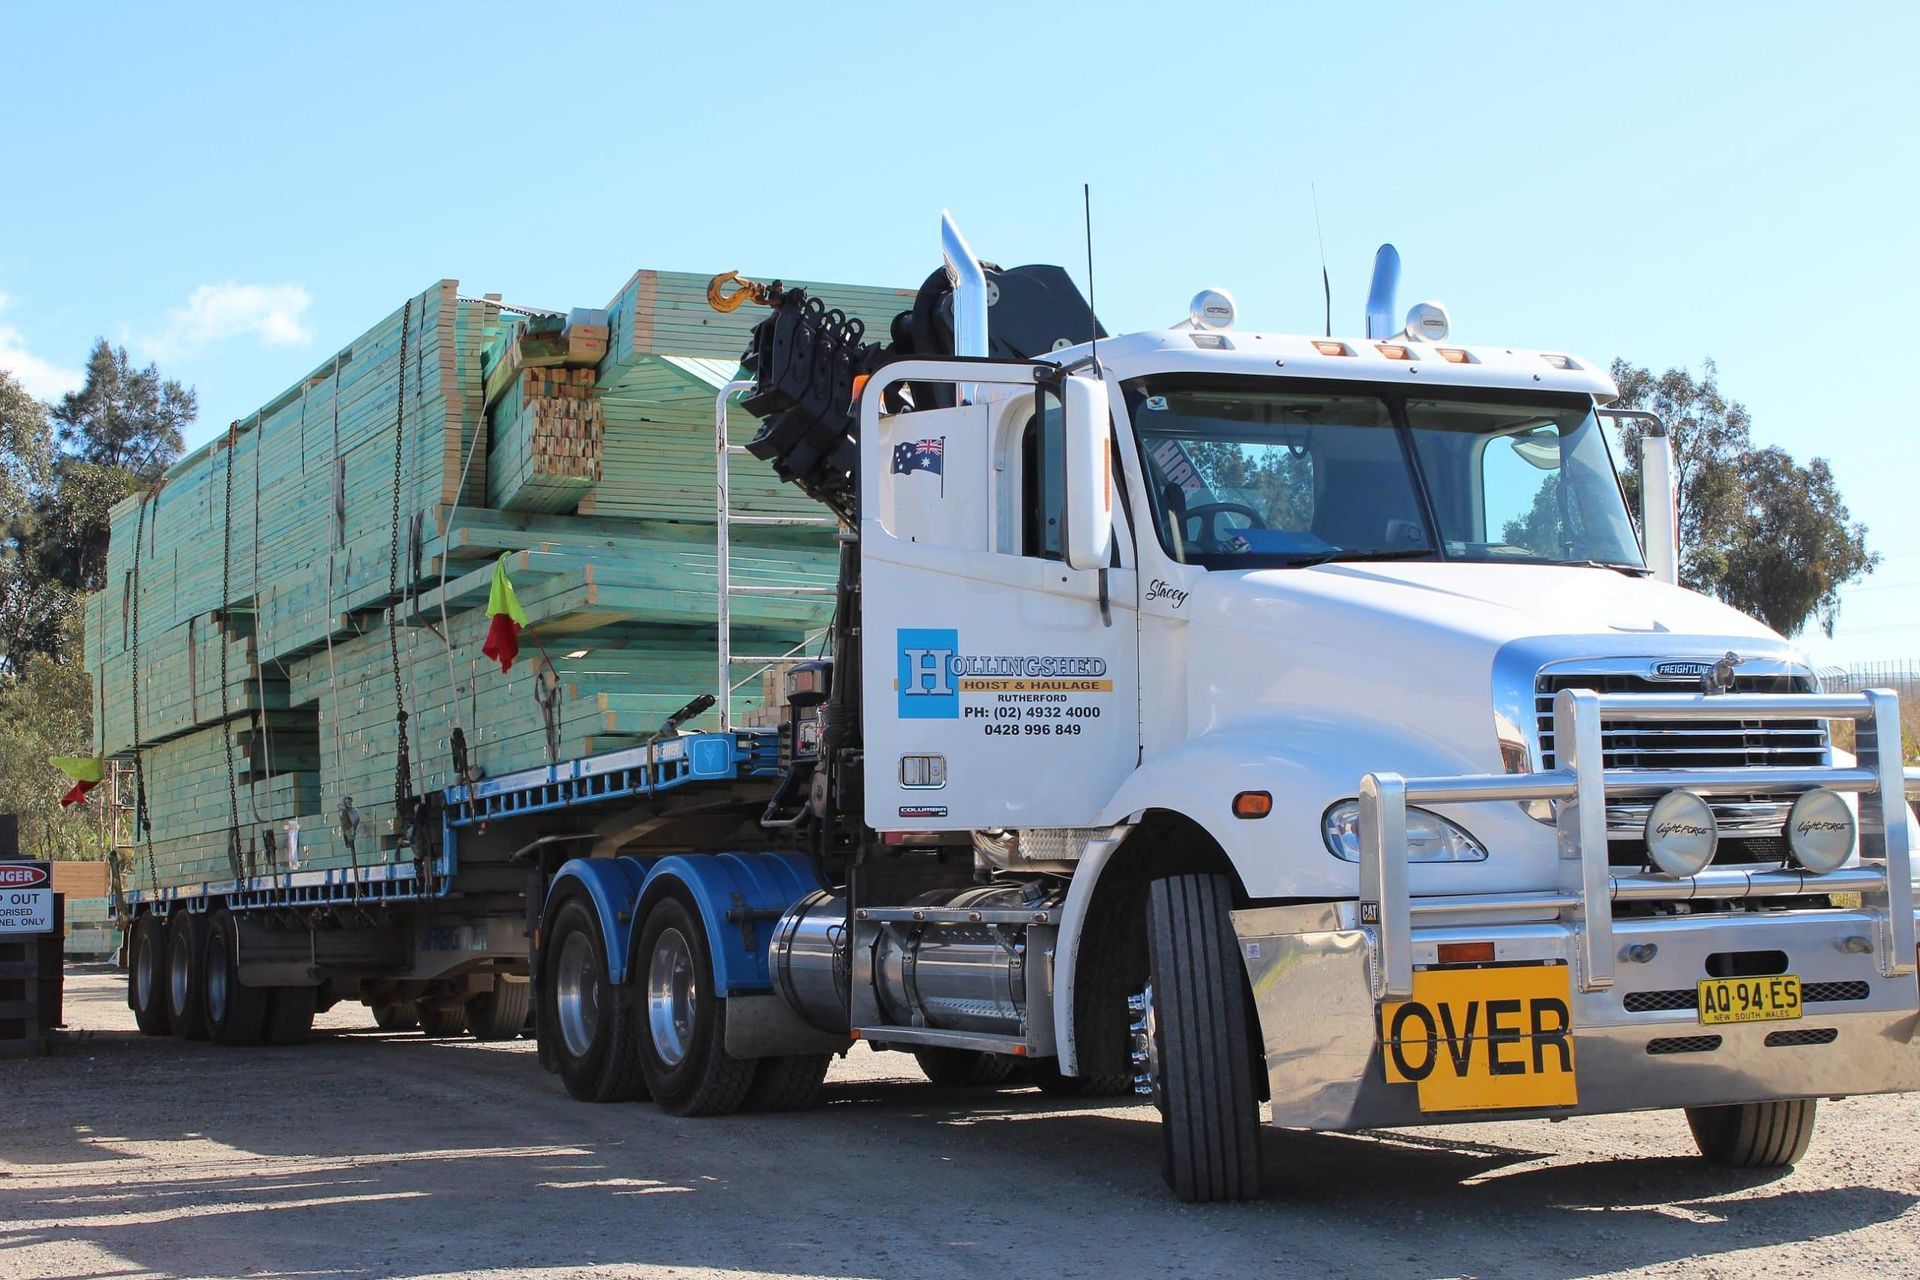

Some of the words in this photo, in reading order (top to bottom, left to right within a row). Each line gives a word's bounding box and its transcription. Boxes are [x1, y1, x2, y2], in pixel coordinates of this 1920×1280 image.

[1145, 579, 1189, 609] Stacey
[904, 648, 1107, 696] HOLLINGSHED
[1660, 664, 1713, 674] FREIGHTLINE
[964, 681, 1010, 690] HOIST
[1015, 681, 1025, 690] &
[1031, 681, 1100, 690] HAULAGE
[997, 694, 1068, 702] RUTHERFORD
[964, 707, 989, 718] PH:
[994, 706, 1022, 720] (02)
[1026, 707, 1061, 718] 4932
[1065, 707, 1101, 718] 4000
[984, 724, 1020, 735] 0428
[1024, 724, 1051, 735] 996
[1055, 724, 1081, 735] 849
[11, 893, 40, 905] OUT
[0, 908, 33, 916] ORISED
[1362, 904, 1377, 921] CAT
[21, 918, 45, 926] ONLY
[1714, 1013, 1731, 1021] NEW
[1735, 1011, 1760, 1020] SOUTH
[1765, 1009, 1790, 1018] WALES
[1390, 997, 1574, 1081] OVER
